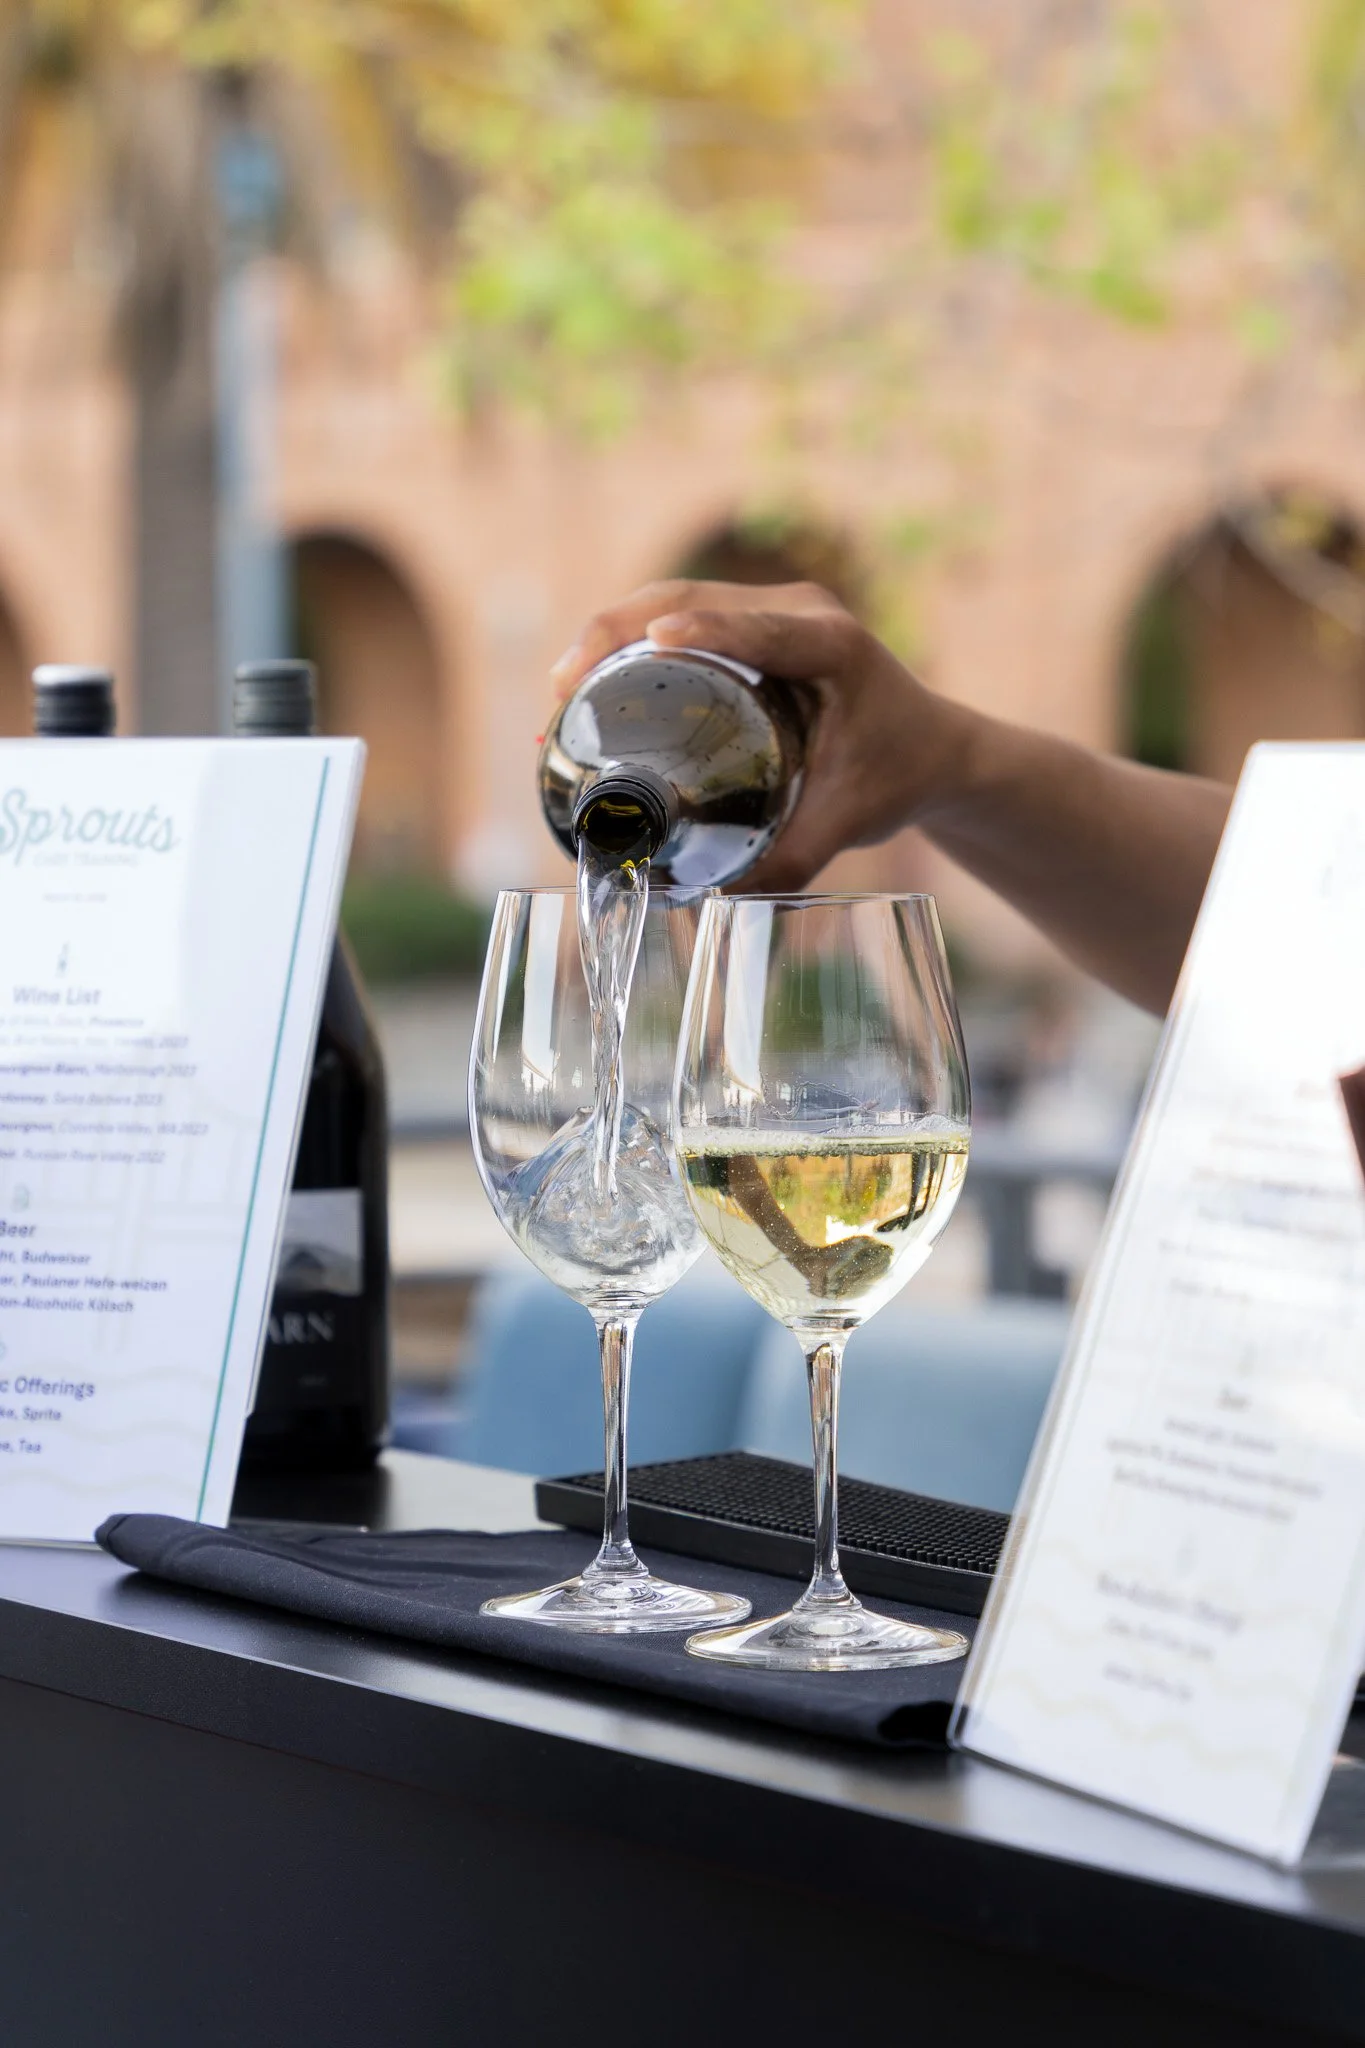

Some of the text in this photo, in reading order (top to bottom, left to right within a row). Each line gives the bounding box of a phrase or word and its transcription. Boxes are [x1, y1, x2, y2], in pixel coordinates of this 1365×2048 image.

[0, 786, 182, 868] Sprouts
[13, 985, 102, 1006] Wine List
[0, 1220, 36, 1238] Beer
[21, 1250, 91, 1266] Budweiser
[22, 1273, 80, 1290] Paulaner
[14, 1375, 96, 1401] Offerings
[22, 1405, 61, 1422] Sprite
[19, 1437, 42, 1455] Tea
